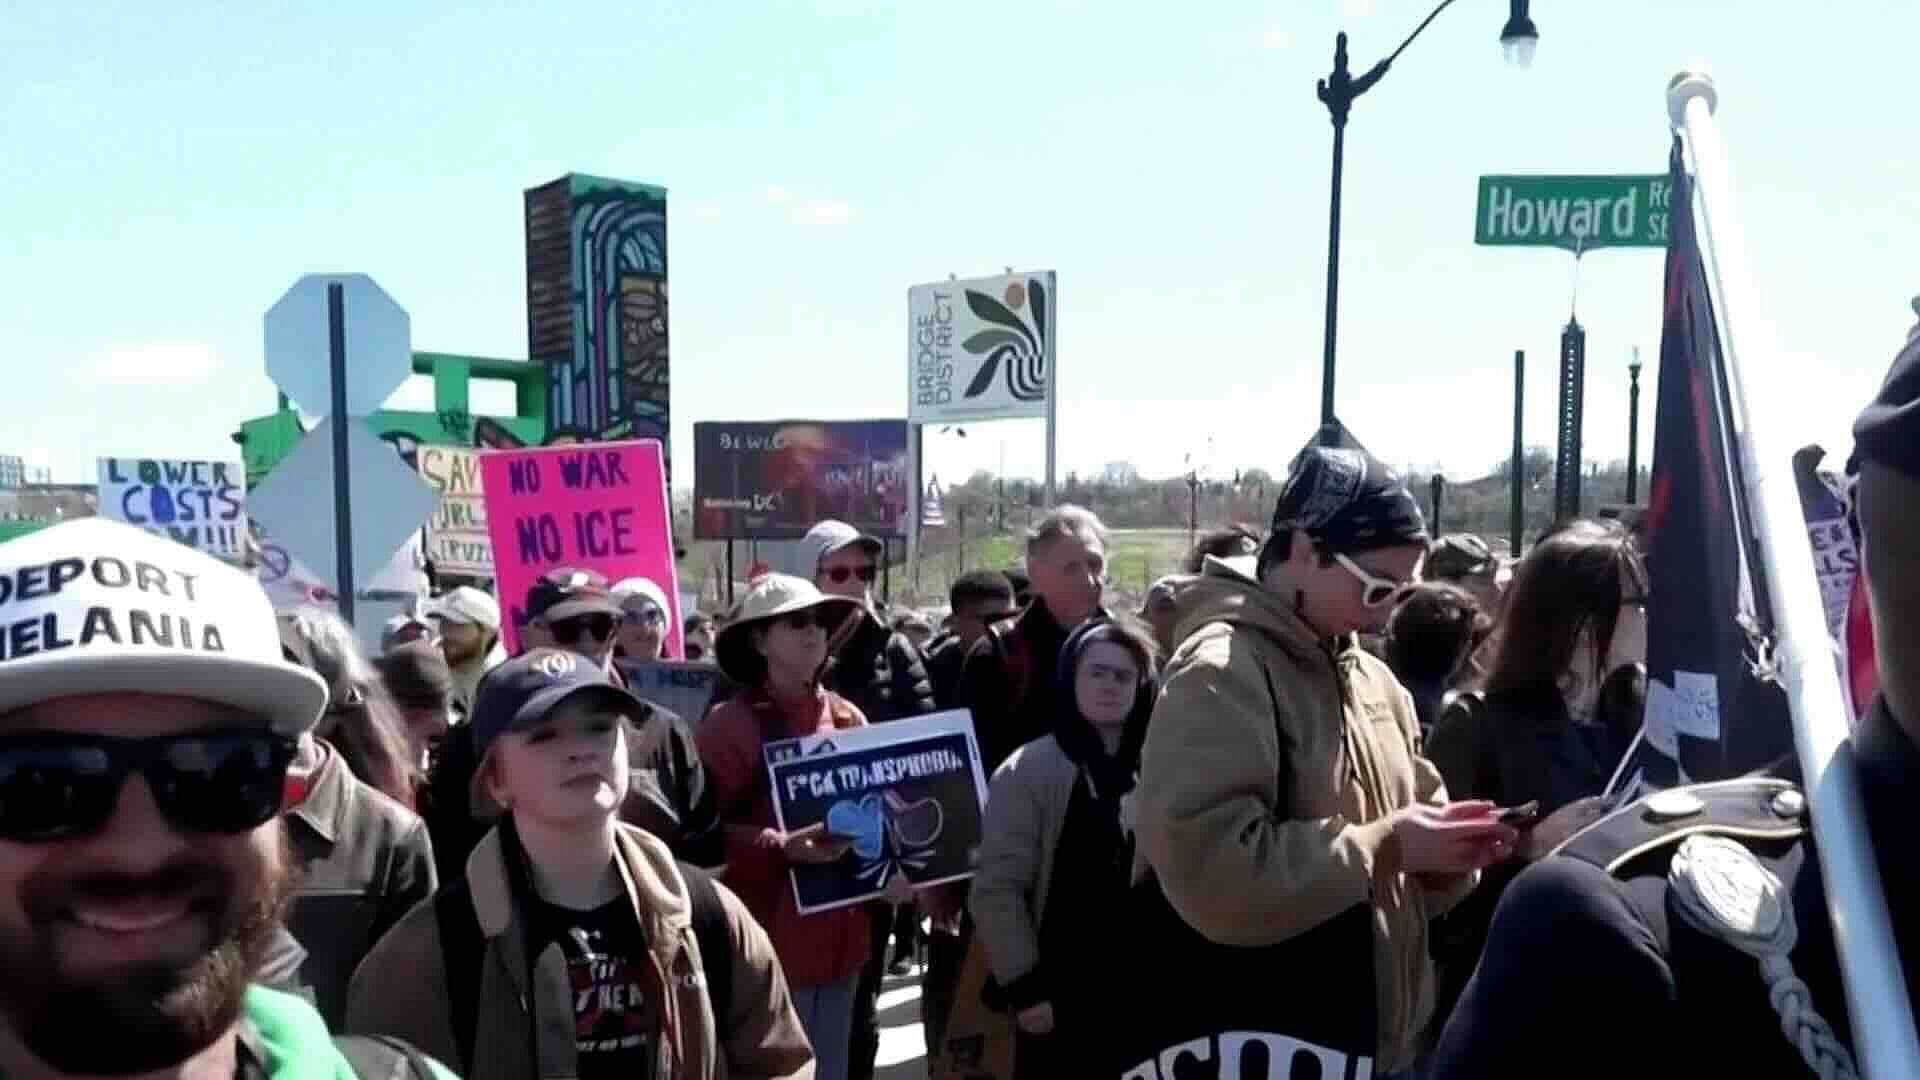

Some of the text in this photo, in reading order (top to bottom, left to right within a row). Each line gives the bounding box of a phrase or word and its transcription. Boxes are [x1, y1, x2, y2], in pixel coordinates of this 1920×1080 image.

[1487, 186, 1637, 237] Howard
[917, 314, 934, 407] BRIDGE
[934, 290, 953, 405] DISTRICT
[108, 458, 240, 488] LOWER
[509, 451, 630, 495] NO WAR
[122, 484, 241, 524] COSTS
[516, 512, 564, 565] NO
[574, 507, 638, 558] ICE
[0, 606, 225, 661] ELANIA
[838, 749, 964, 790] TRANSPHOBIA
